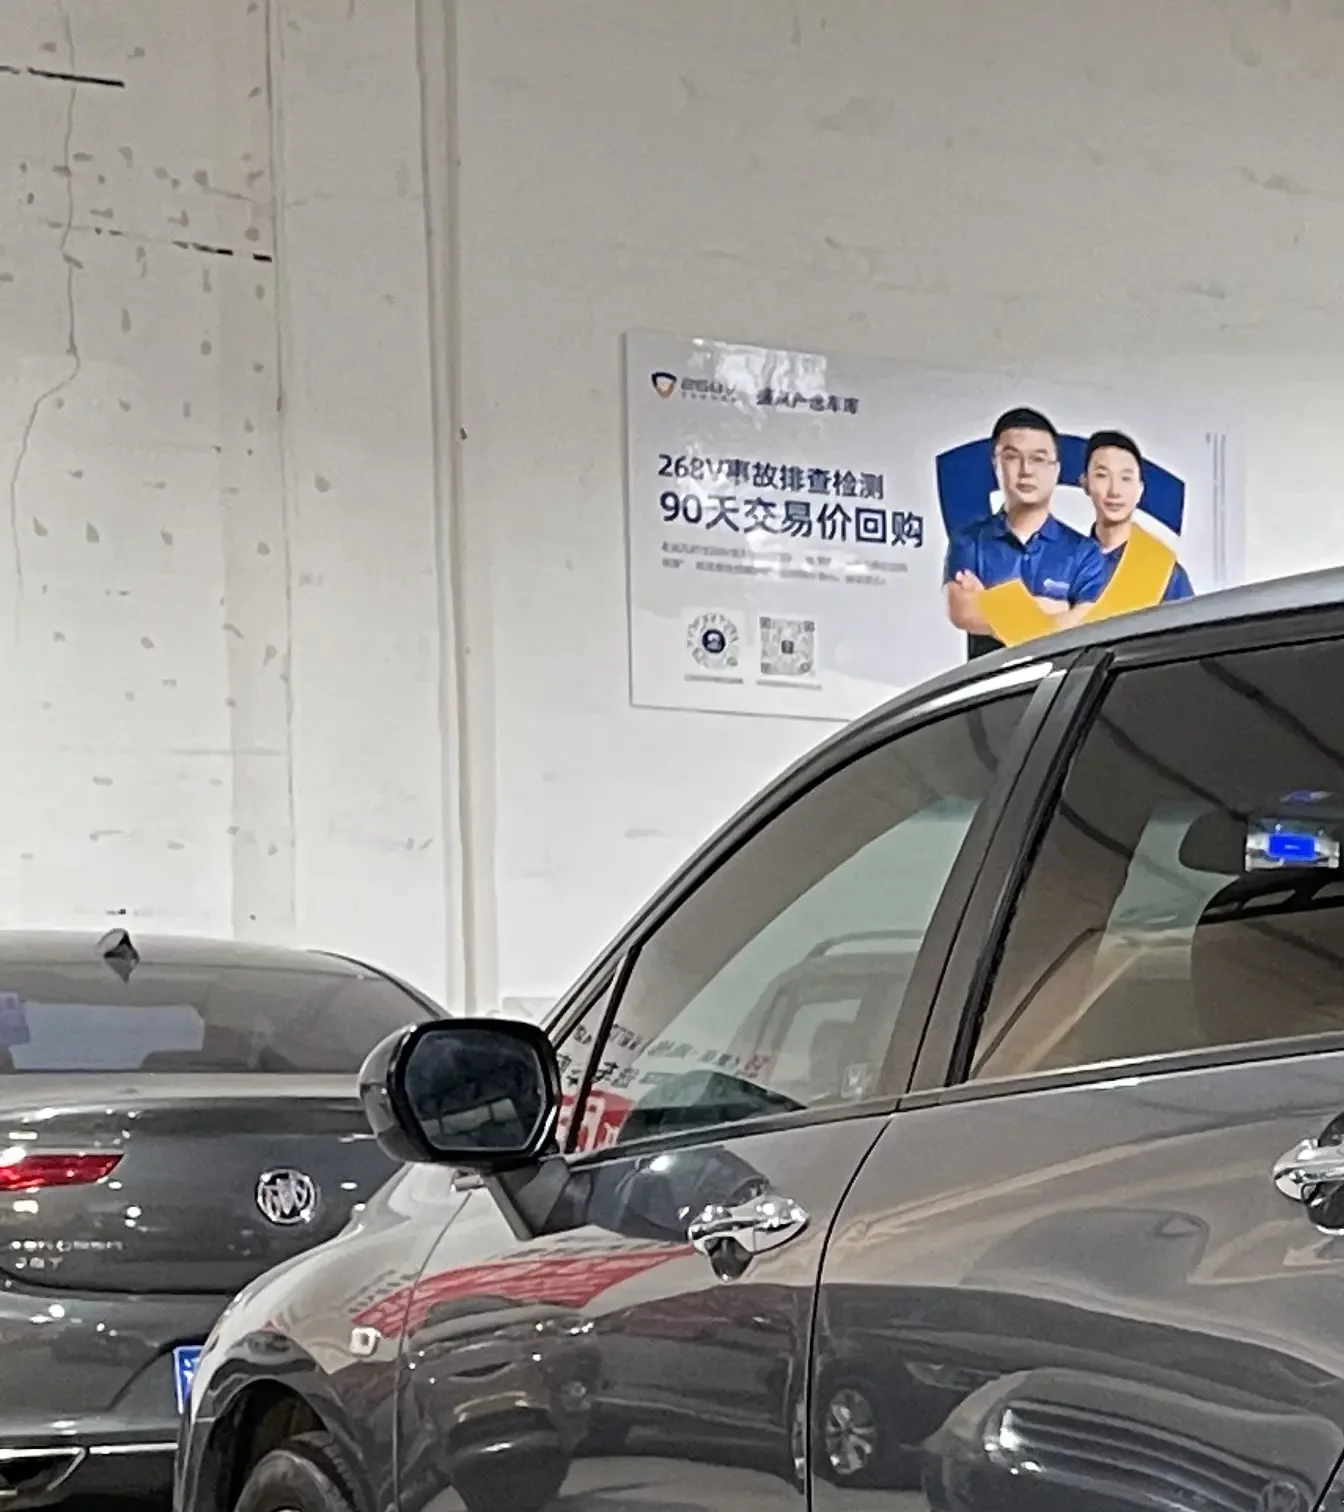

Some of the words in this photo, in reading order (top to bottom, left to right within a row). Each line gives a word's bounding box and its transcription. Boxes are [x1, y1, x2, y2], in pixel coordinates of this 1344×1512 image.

[660, 491, 924, 548] 90天交易价回购
